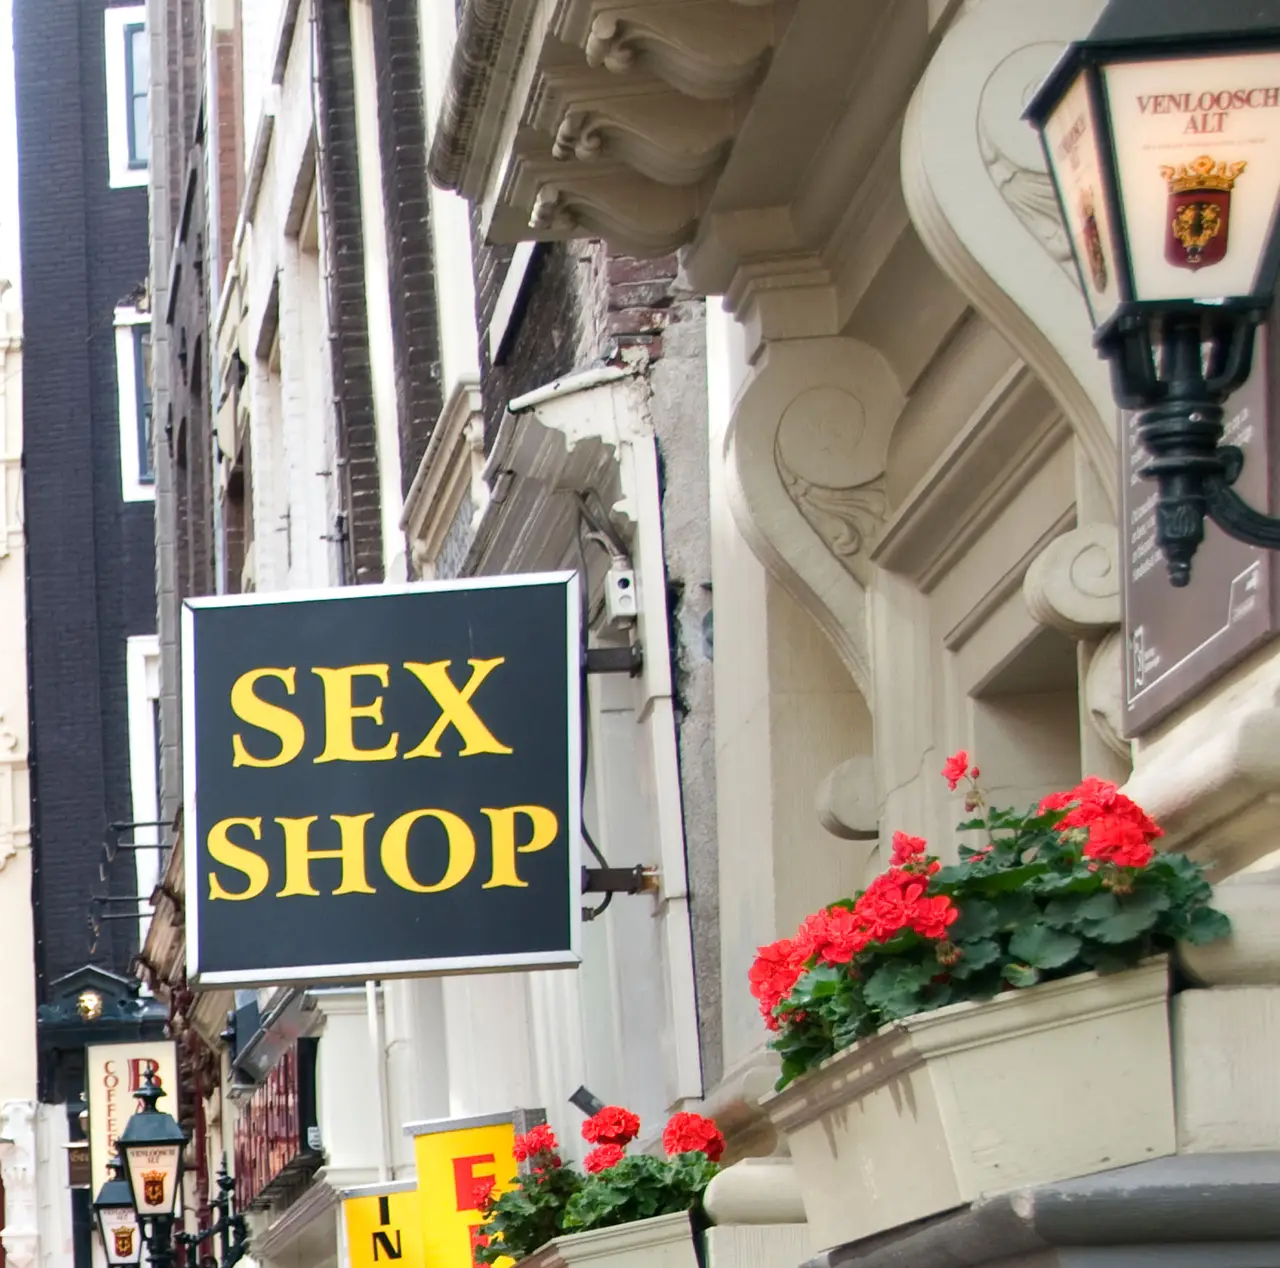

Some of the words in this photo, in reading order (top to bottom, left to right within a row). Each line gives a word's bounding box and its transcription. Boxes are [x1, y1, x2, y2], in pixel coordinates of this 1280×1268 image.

[1136, 87, 1280, 115] VENLOOSCH
[1183, 112, 1229, 134] ALT
[230, 655, 513, 768] SEX
[207, 804, 560, 903] SHOP
[372, 1195, 403, 1262] IN
